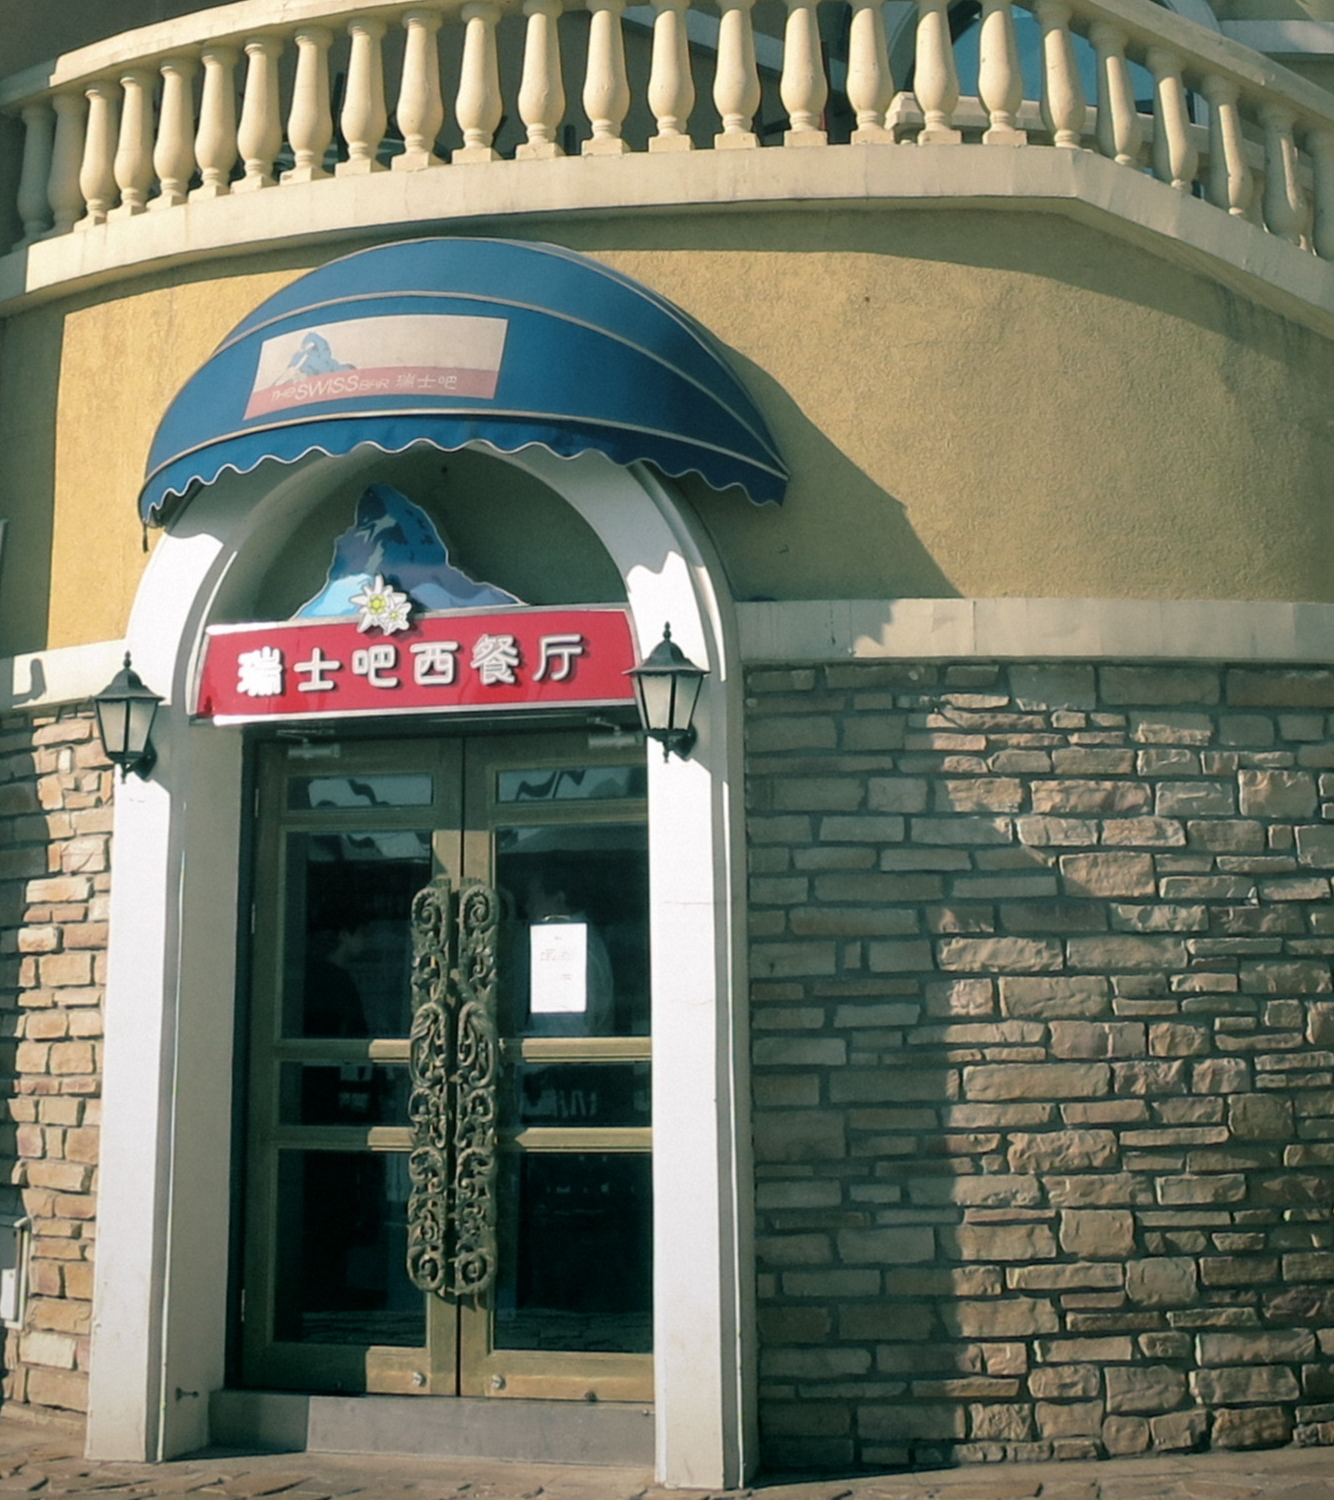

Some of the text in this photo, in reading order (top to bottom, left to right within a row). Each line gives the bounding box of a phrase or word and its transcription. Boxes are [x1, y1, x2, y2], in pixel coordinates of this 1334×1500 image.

[294, 375, 359, 400] SWISS
[395, 372, 457, 391] 瑞士吧
[236, 633, 584, 696] 瑞士吧西餐厅
